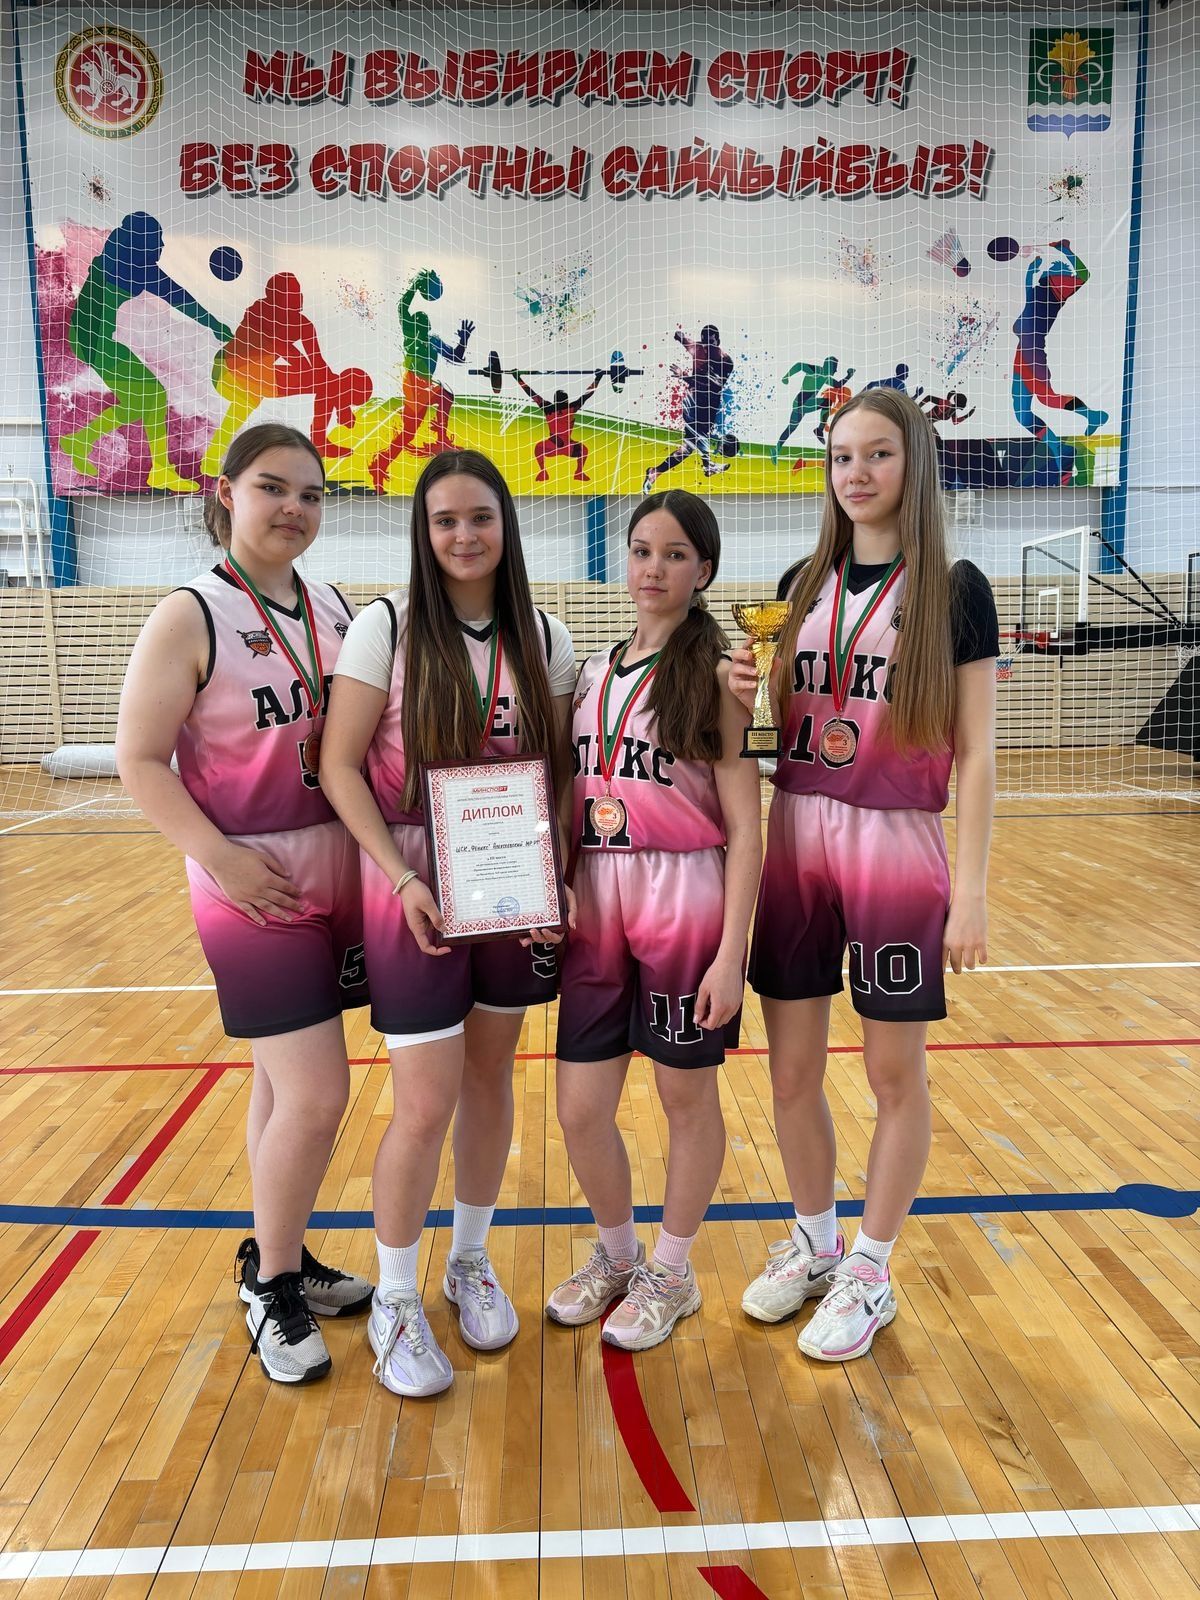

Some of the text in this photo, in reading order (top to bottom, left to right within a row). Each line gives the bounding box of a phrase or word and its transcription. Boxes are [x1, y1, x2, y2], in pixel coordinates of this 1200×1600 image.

[243, 47, 910, 105] МЫ ВЫБИРАЕМ СПОРТ!
[179, 136, 991, 199] БЕЗ СПОРТНЫ САЙЛЫЙБЫЗ!
[461, 804, 523, 823] ДИПЛОМ
[338, 942, 367, 989] 5
[849, 942, 923, 996] 10
[649, 991, 704, 1045] 11
